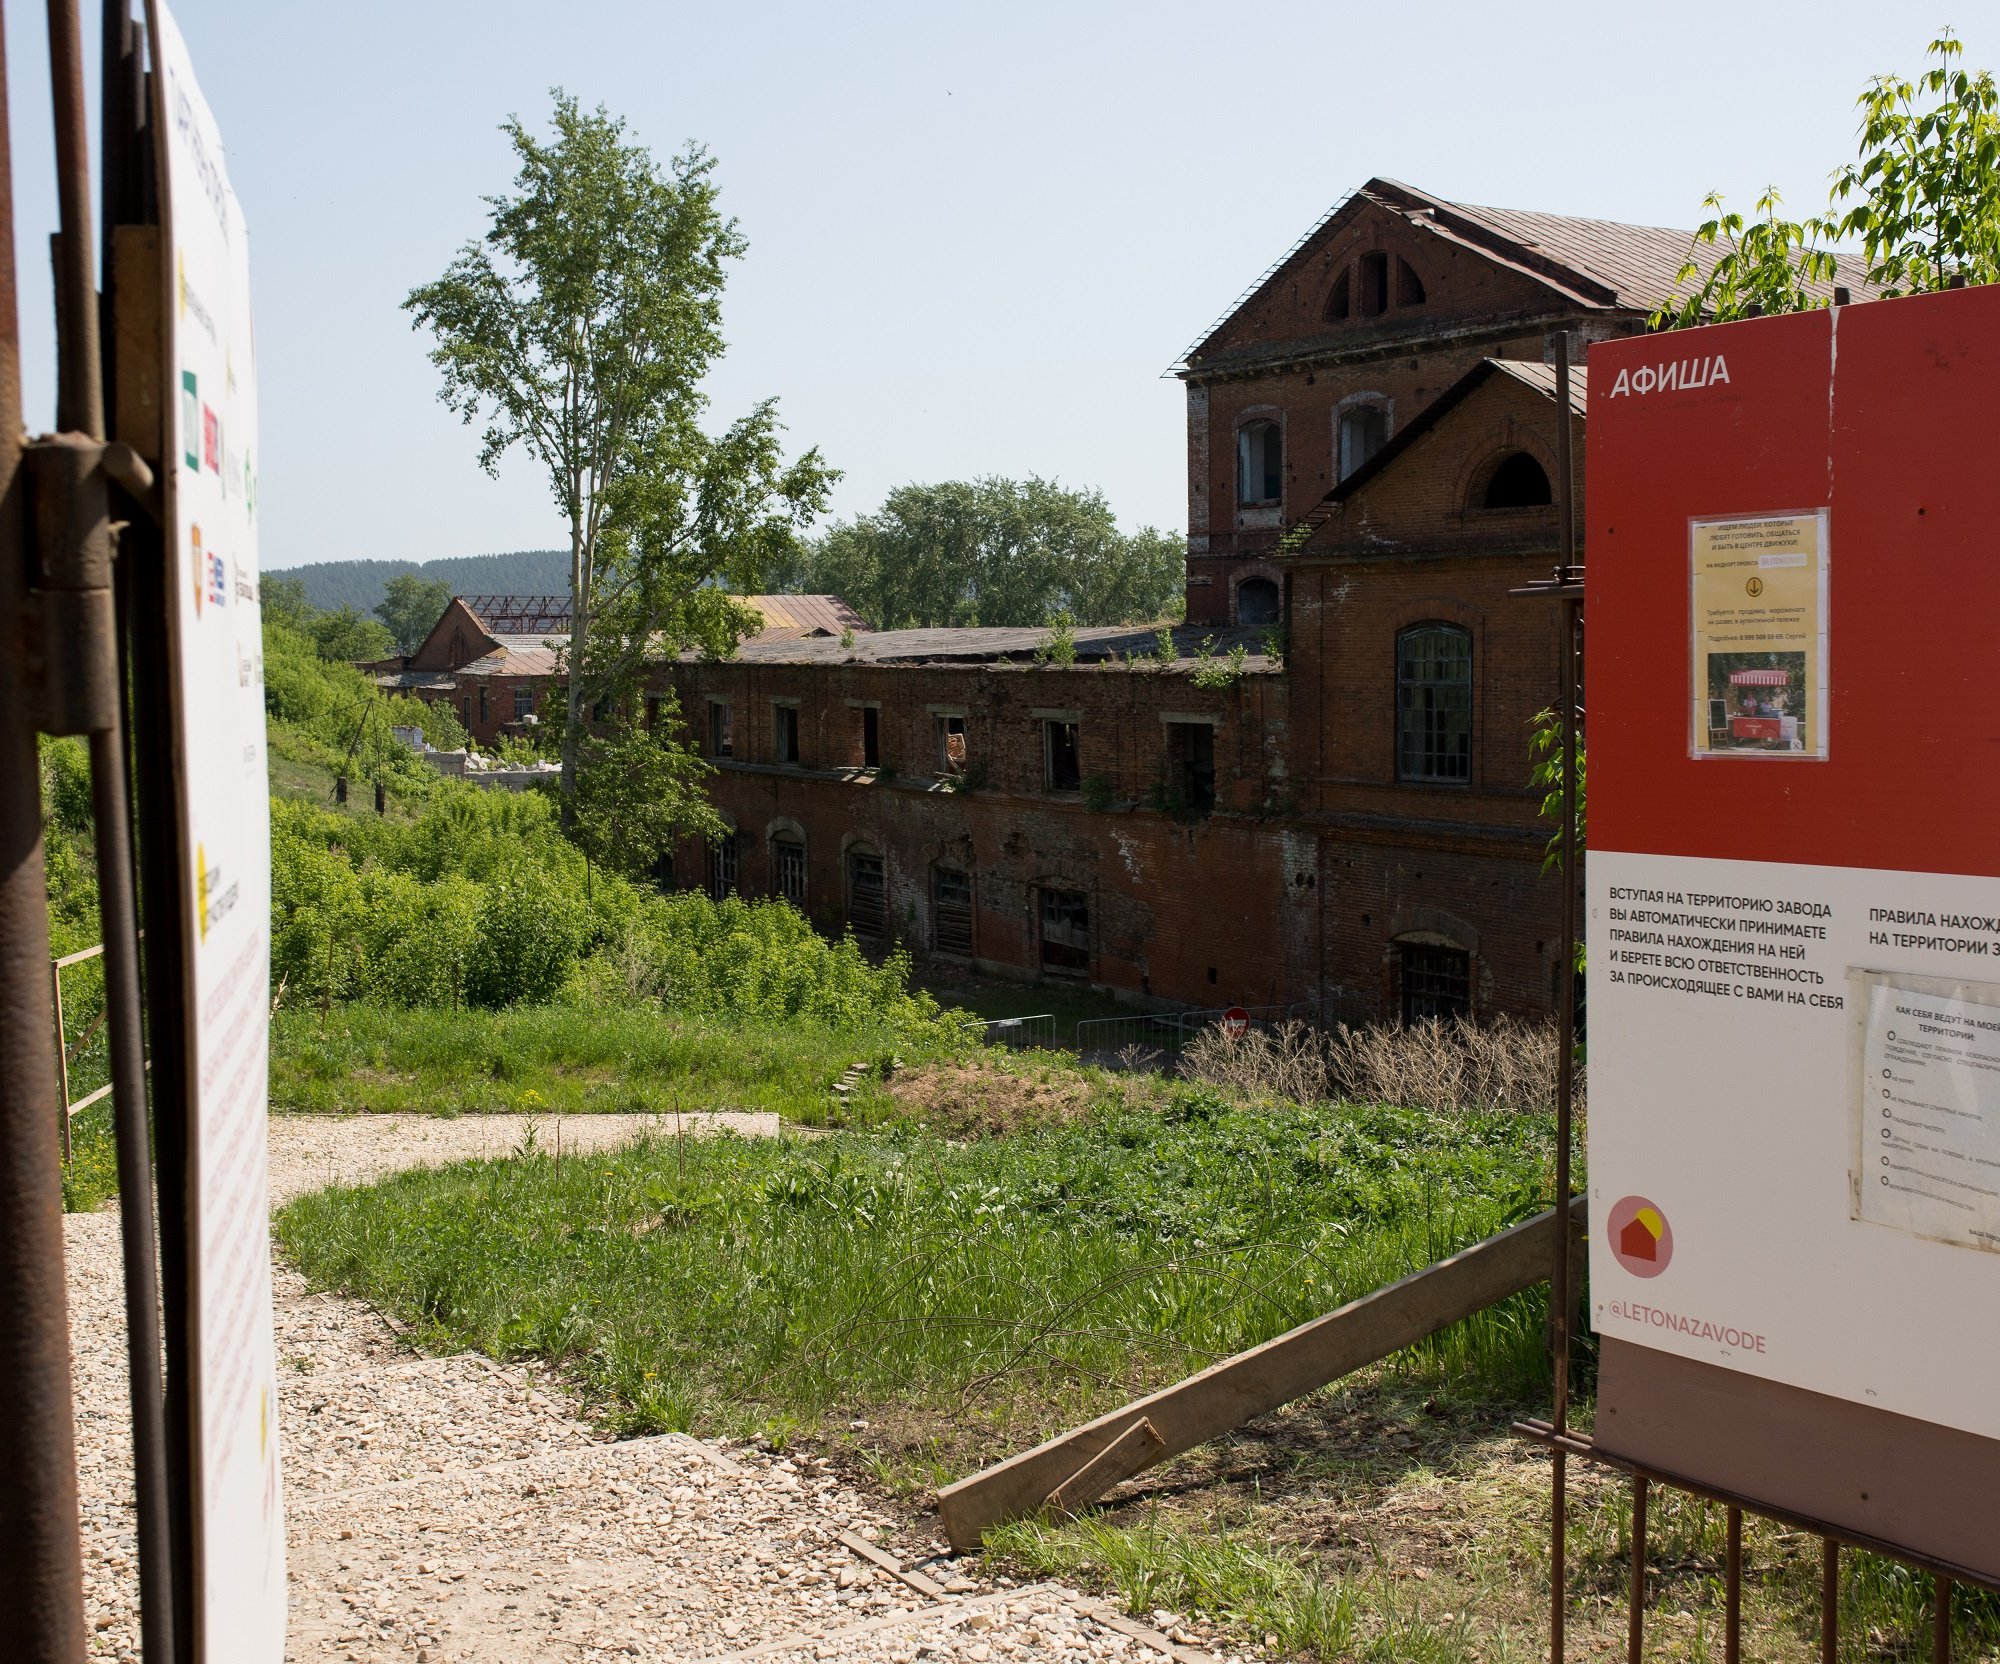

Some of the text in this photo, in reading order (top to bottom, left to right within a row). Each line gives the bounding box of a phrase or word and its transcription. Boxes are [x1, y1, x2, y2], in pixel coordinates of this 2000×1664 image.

[1609, 355, 1731, 399] АФИША
[1609, 887, 1832, 918] ВСТУПАЯ НА ТЕРРИТОРИЮ ЗАВОДА
[1869, 908, 1936, 926] ПРАВИЛА
[1609, 908, 1826, 939] ВЫ АВТОМАТИЧЕСКИ ПРИНИМАЕТЕ
[1609, 929, 1806, 960] ПРАВИЛА НАХОЖДЕНИЯ НА НЕЙ
[1869, 931, 1889, 946] НА
[1892, 933, 1988, 955] ТЕРРИТОРИИ
[1609, 949, 1824, 984] И БЕРЕТЕ ВСЮ ОТВЕТСТВЕННОСТЬ
[1609, 970, 1844, 1010] ЗА ПРОИСХОДЯЩЕЕ С ВАМИ НА СЕБЯ
[1895, 1005, 1911, 1015] КАК
[1912, 1009, 1932, 1019] СЕБЯ
[1934, 1012, 1962, 1024] ВЕДУТ
[1963, 1017, 1976, 1027] НА
[1608, 1300, 1767, 1354] @LETONAZAVODE
